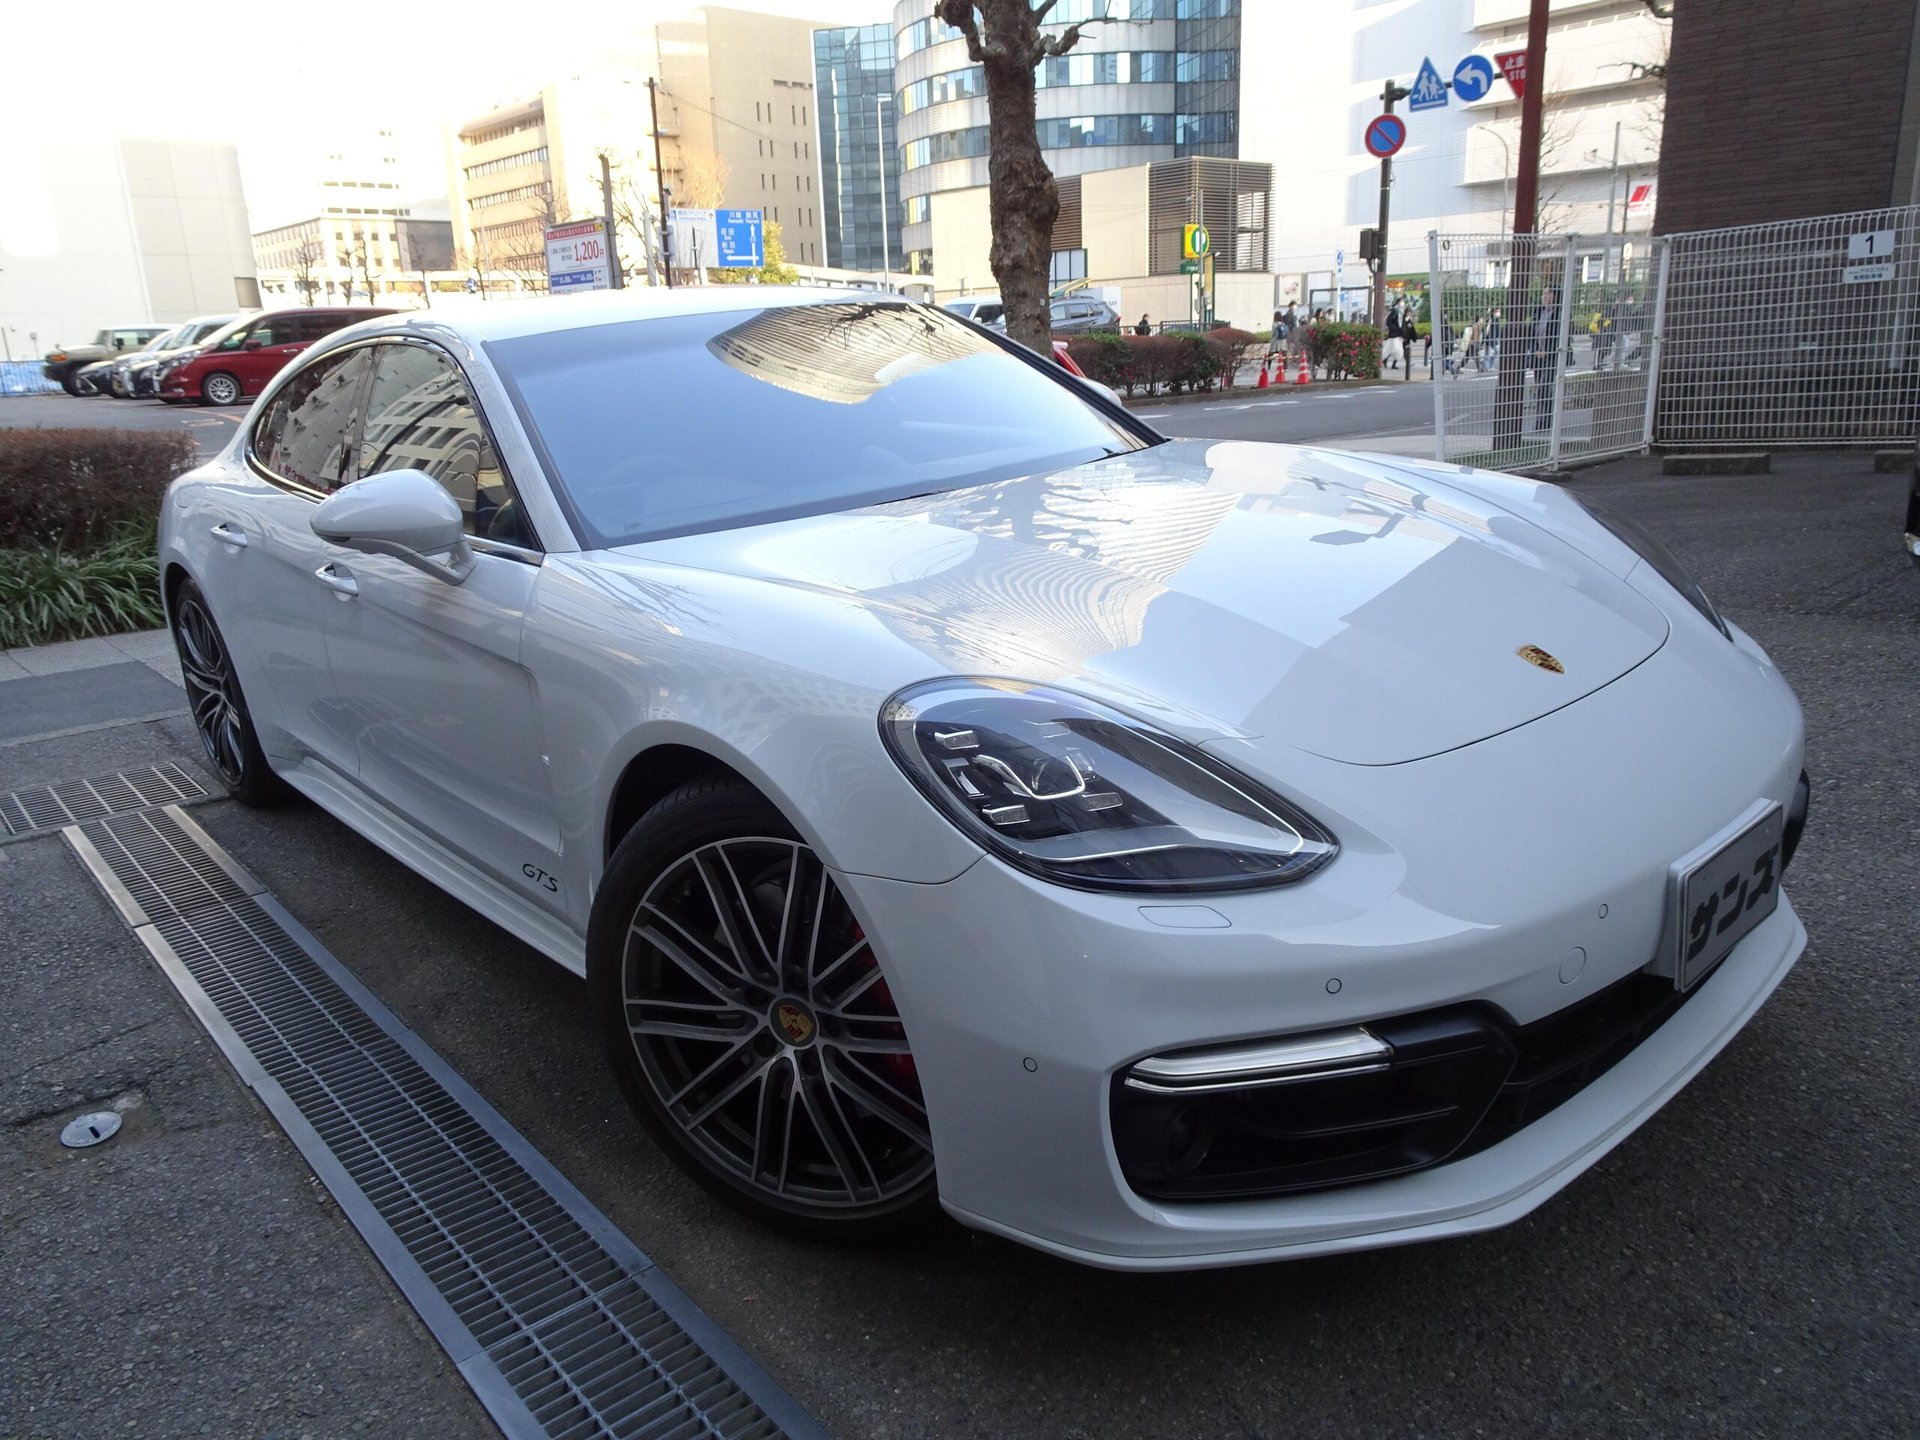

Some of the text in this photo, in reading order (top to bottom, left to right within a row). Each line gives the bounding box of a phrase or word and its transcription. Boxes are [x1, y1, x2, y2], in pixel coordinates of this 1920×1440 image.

[1504, 54, 1526, 70] 止ま
[1509, 69, 1527, 81] STO
[1865, 234, 1874, 254] 1
[522, 863, 558, 892] GTS
